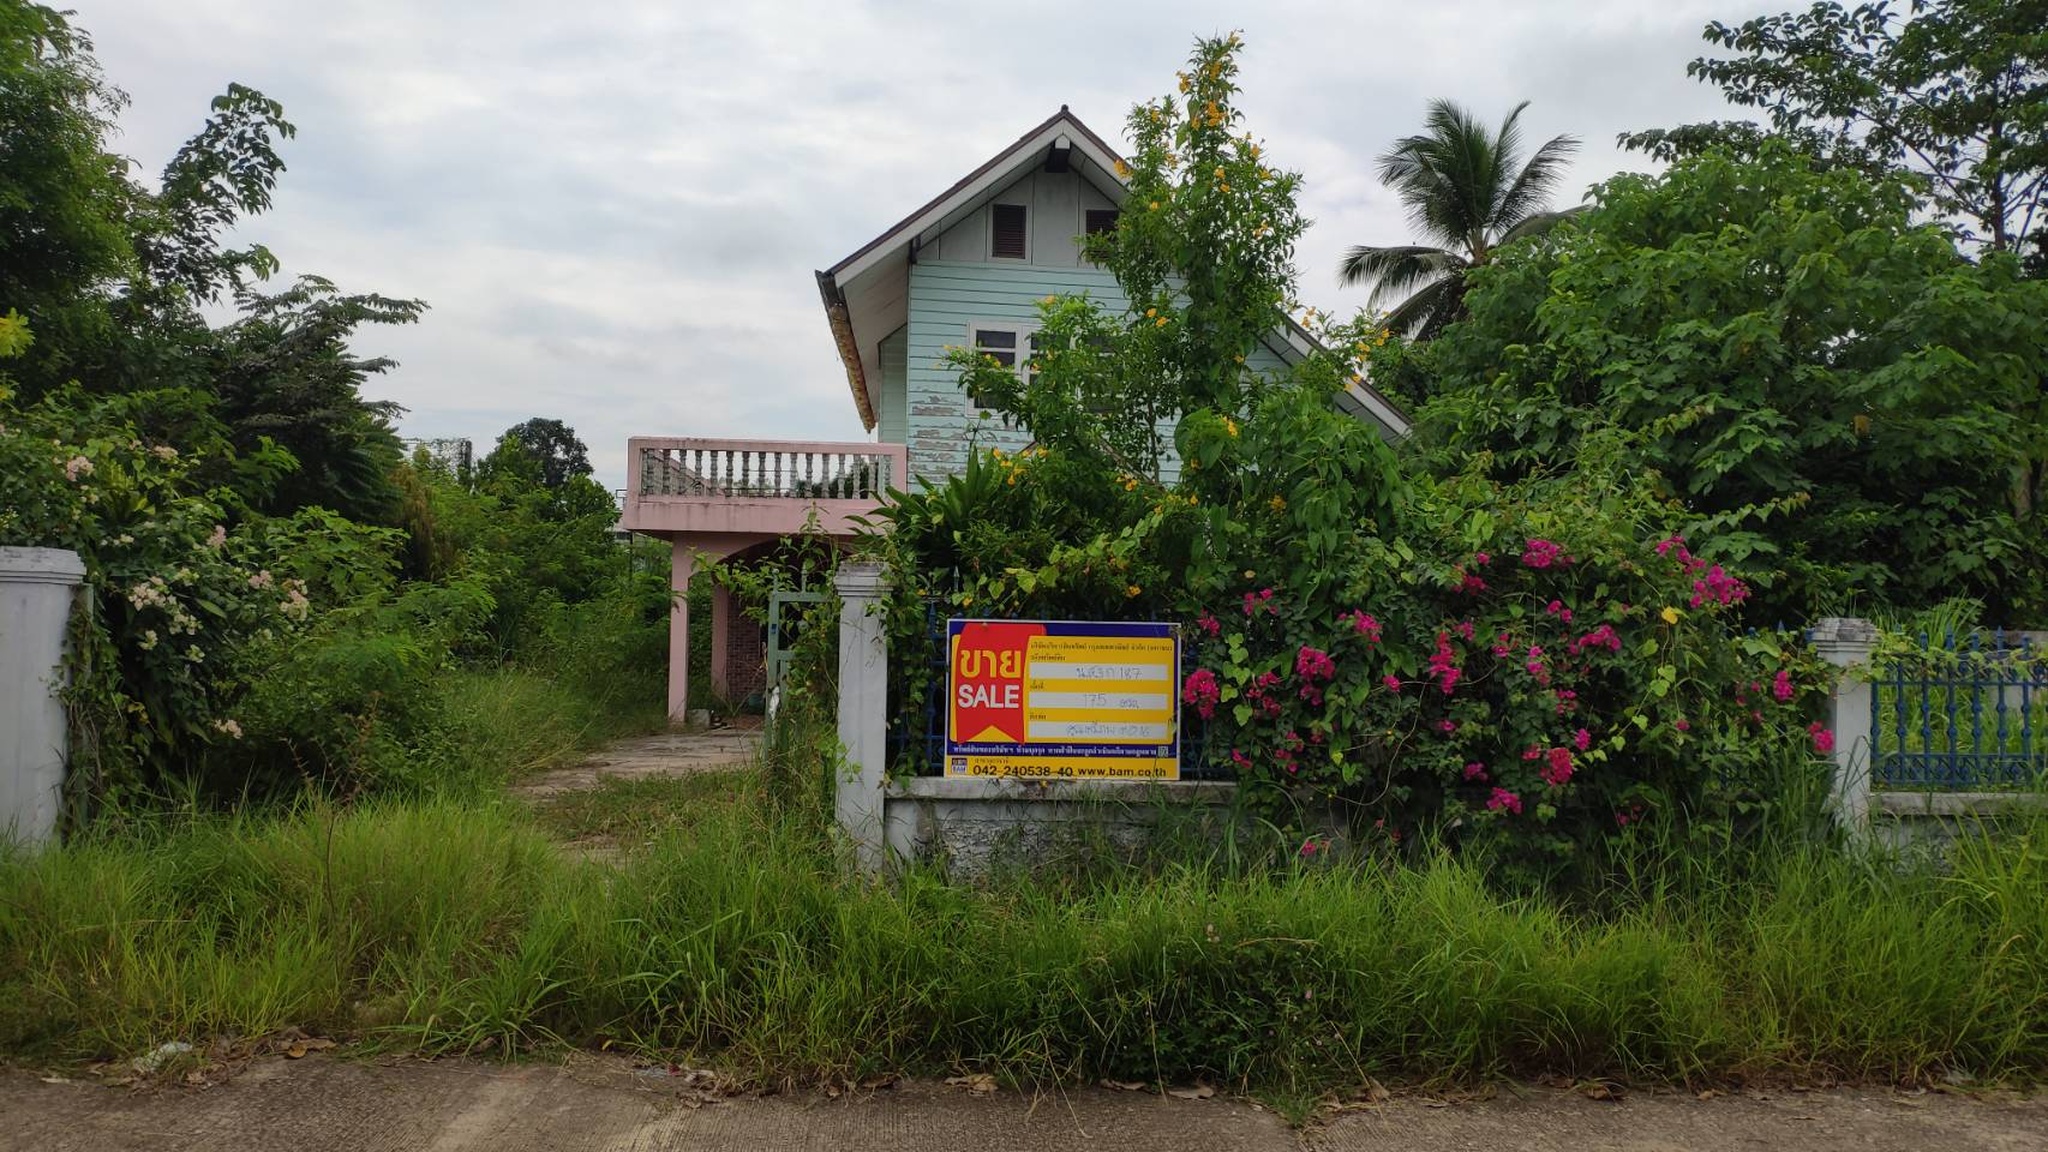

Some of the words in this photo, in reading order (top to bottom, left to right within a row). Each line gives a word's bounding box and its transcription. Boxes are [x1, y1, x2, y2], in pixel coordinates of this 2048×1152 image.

[960, 650, 1021, 678] ขาย
[958, 683, 1020, 708] SALE
[1084, 693, 1106, 708] 175
[1078, 767, 1166, 777] www.bam.co.th
